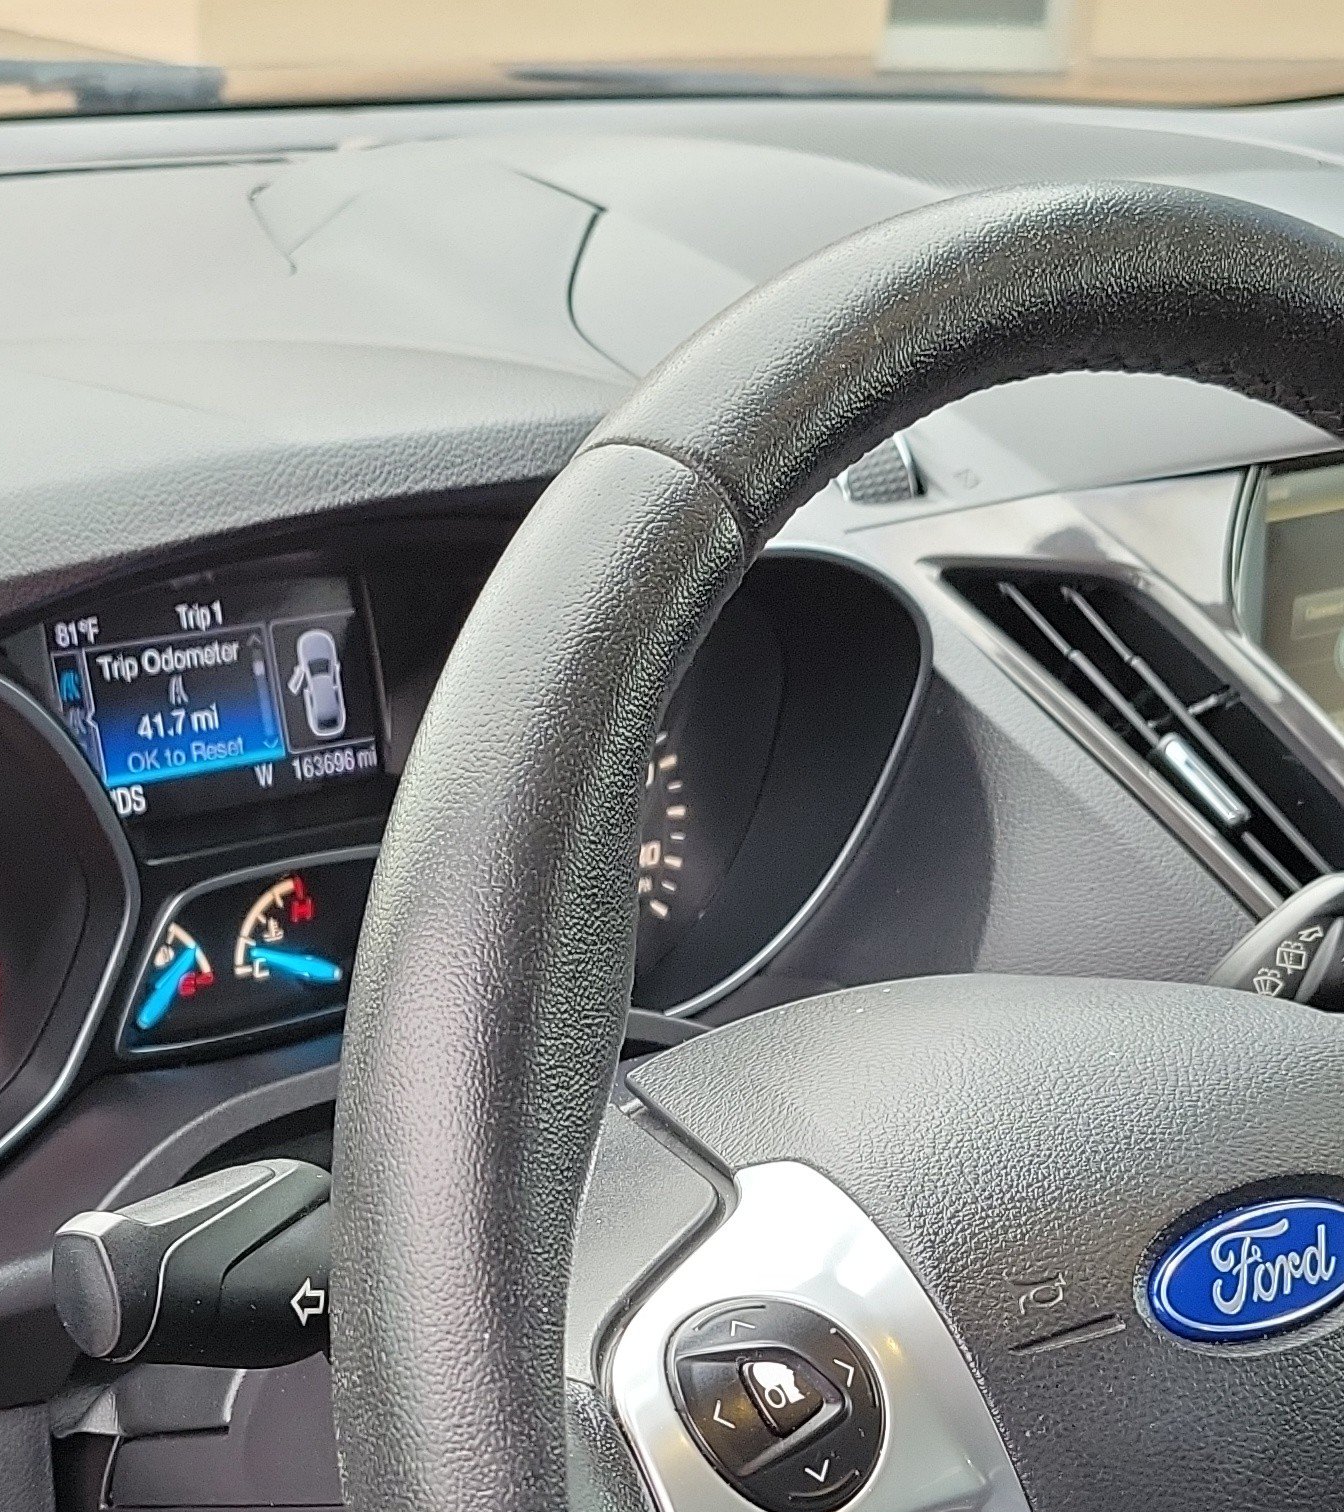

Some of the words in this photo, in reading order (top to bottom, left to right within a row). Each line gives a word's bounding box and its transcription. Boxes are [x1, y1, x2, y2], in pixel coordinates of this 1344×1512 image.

[175, 602, 210, 632] Trip
[96, 652, 139, 683] Trip
[141, 641, 240, 676] Odometer
[137, 708, 186, 741] 41.7
[191, 703, 220, 734] mi
[127, 748, 161, 773] OK
[165, 745, 187, 767] to
[190, 737, 245, 763] Reset
[291, 749, 356, 781] 163696
[356, 745, 378, 768] mi
[254, 763, 274, 788] W
[1211, 1217, 1337, 1315] Ford
